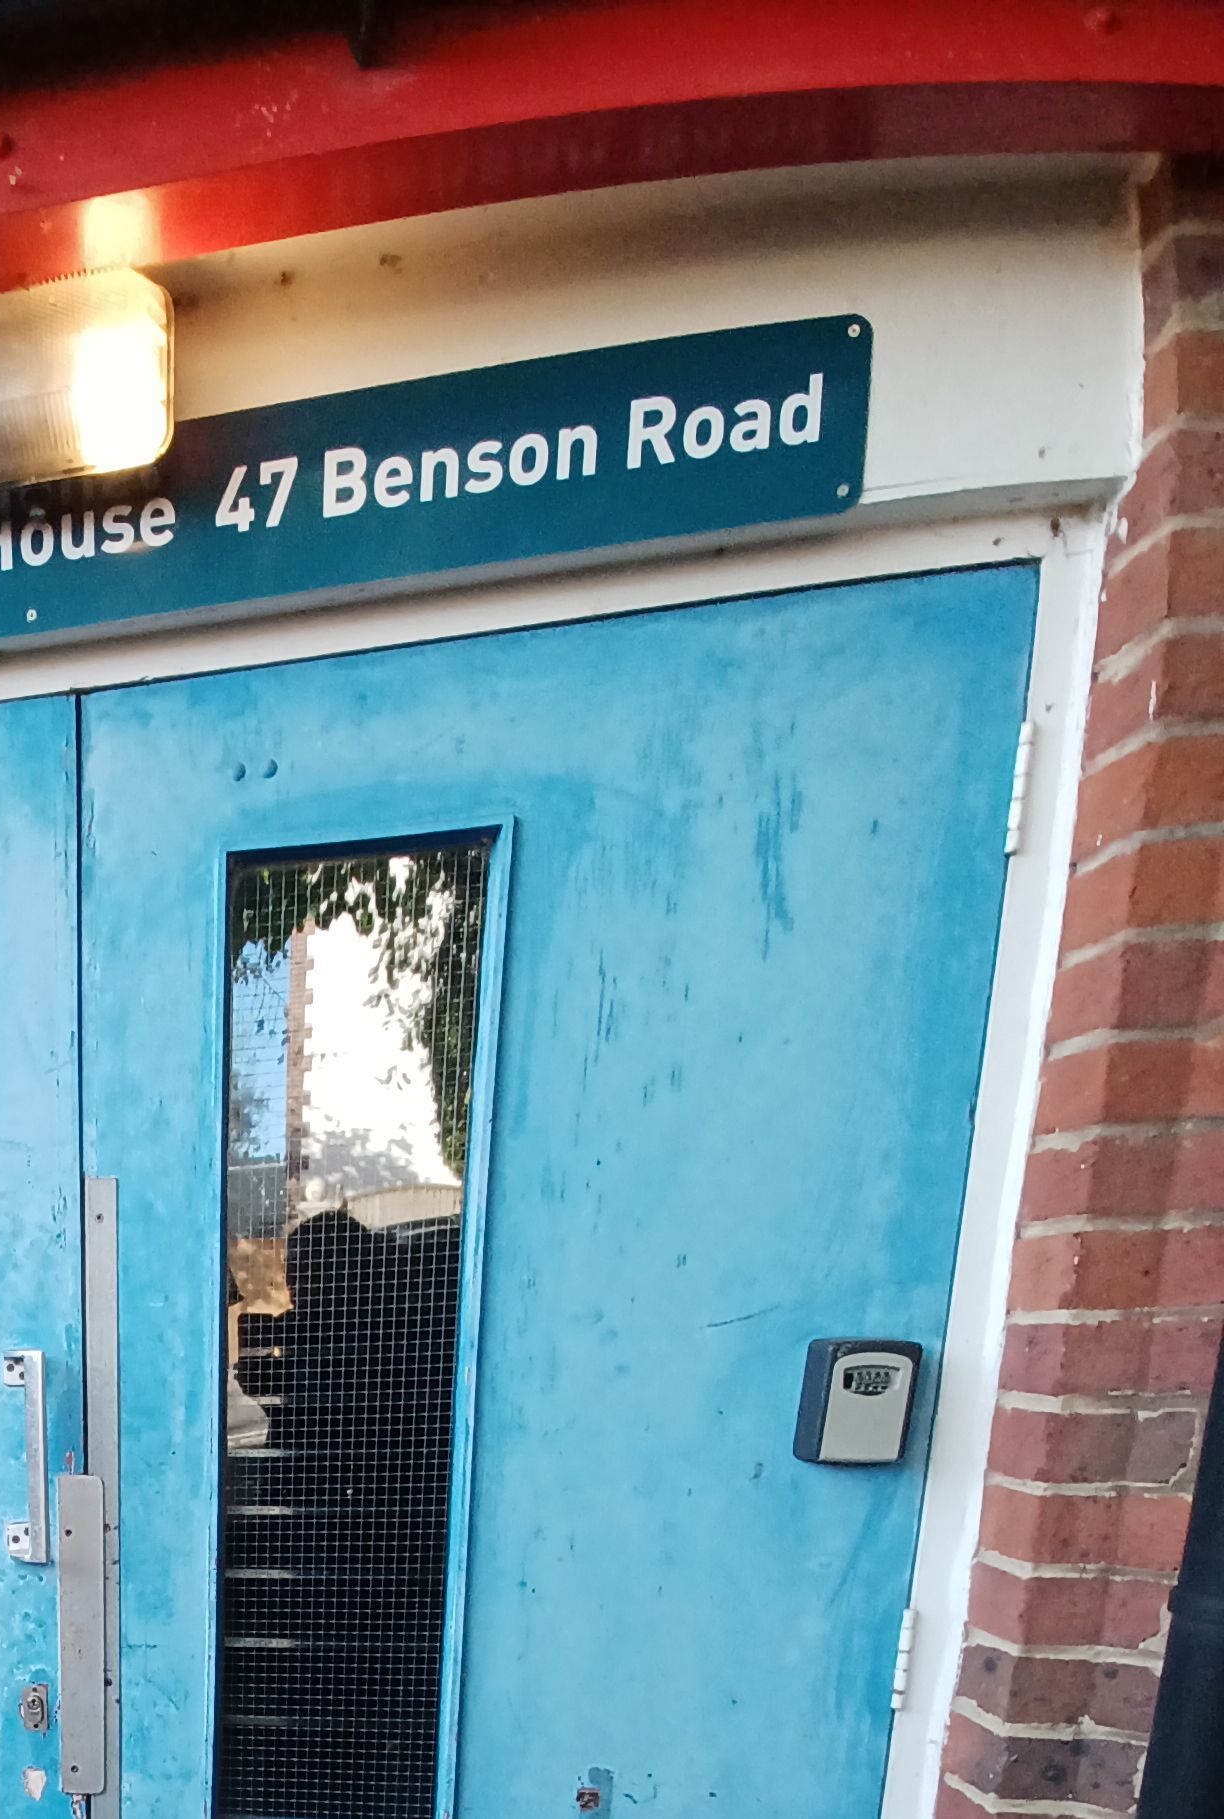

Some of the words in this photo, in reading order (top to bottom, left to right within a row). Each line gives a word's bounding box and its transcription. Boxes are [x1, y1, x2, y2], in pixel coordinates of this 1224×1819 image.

[215, 457, 299, 532] 47
[322, 426, 598, 518] Benson
[627, 374, 823, 469] Road
